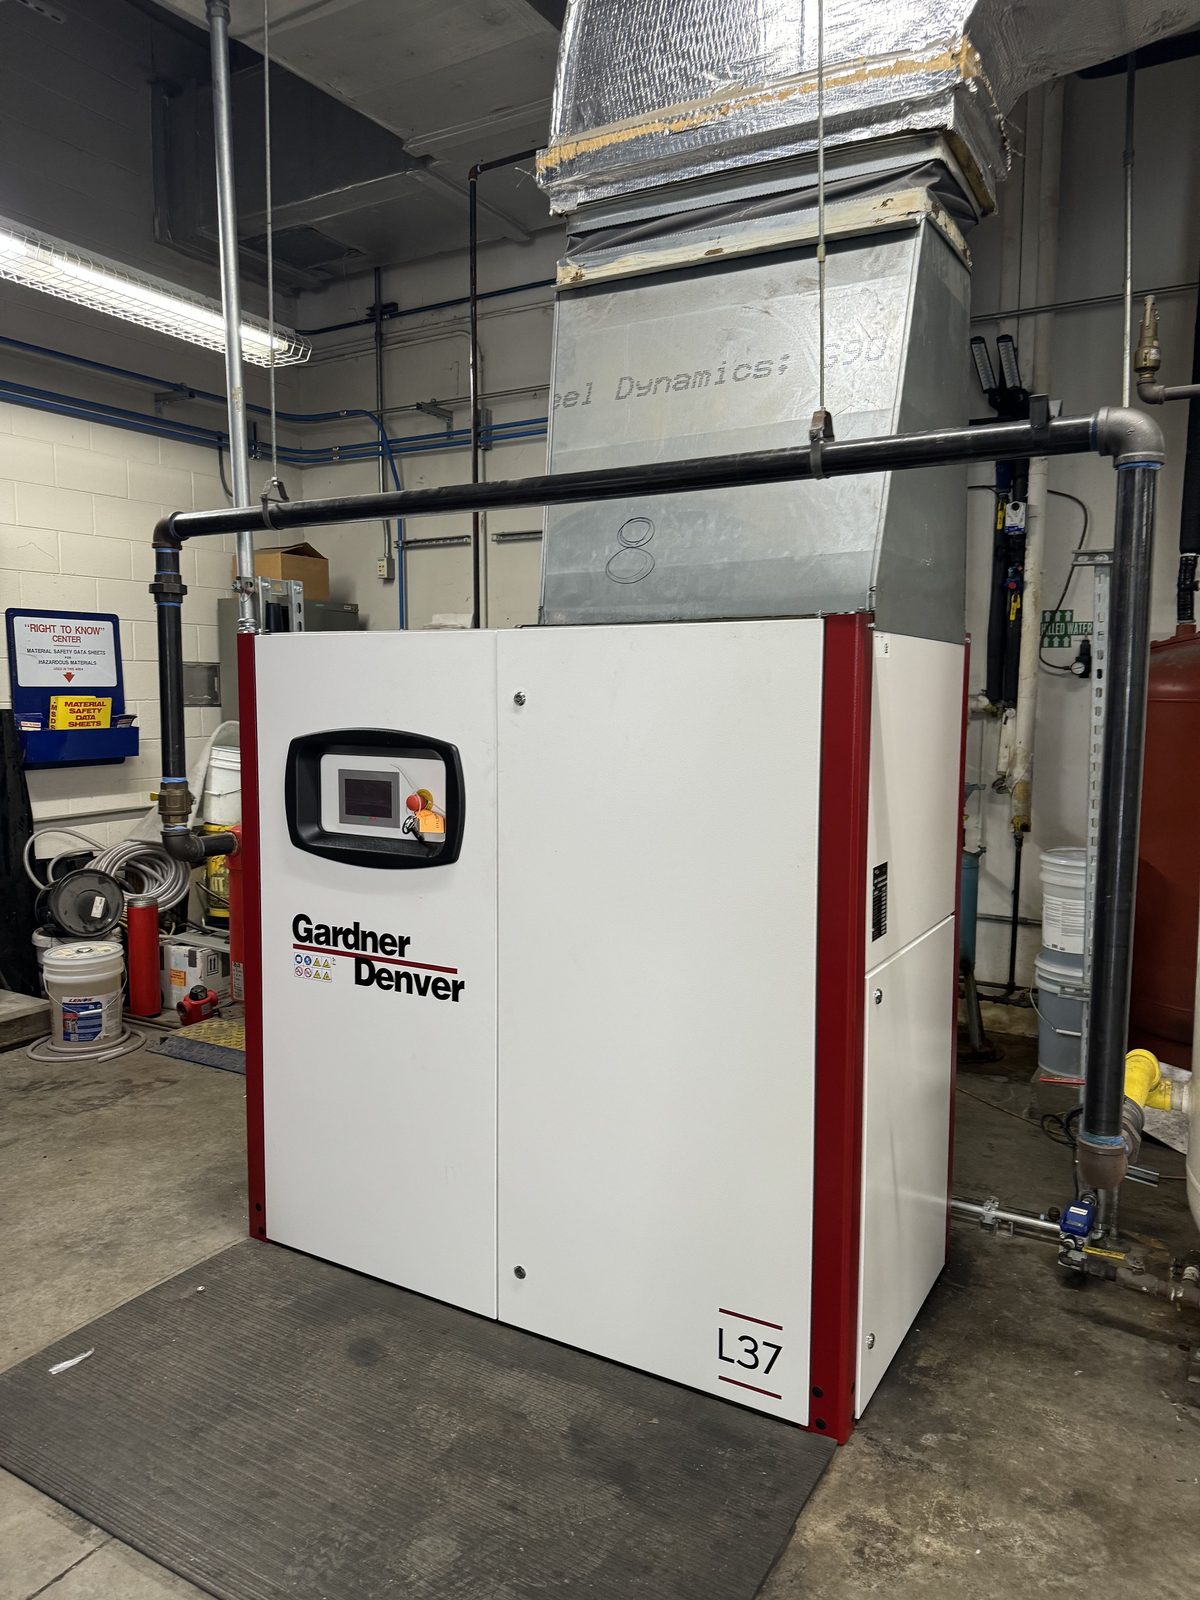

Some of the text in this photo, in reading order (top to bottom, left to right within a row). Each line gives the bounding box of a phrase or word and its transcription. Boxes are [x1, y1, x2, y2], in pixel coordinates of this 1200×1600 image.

[52, 635, 82, 643] CENTER
[60, 625, 72, 634] TO
[1041, 622, 1093, 635] HLLED WATER
[292, 913, 411, 958] Gardner
[354, 957, 465, 1003] Denver
[718, 1327, 783, 1375] L37
